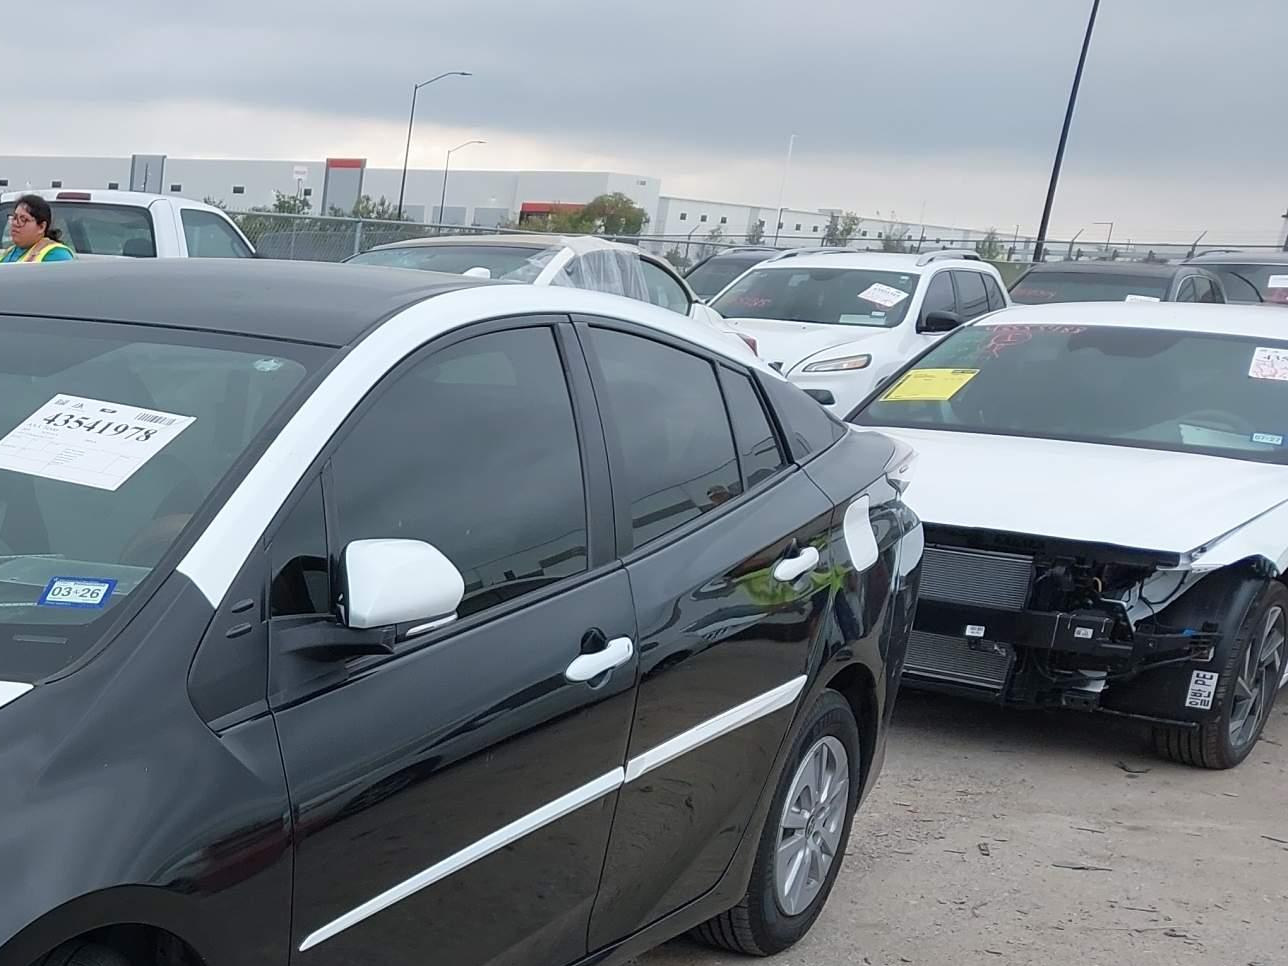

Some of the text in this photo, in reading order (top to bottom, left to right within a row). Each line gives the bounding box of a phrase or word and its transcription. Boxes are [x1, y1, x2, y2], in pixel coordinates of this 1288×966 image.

[43, 412, 158, 442] 43541978
[51, 586, 102, 599] 03 26
